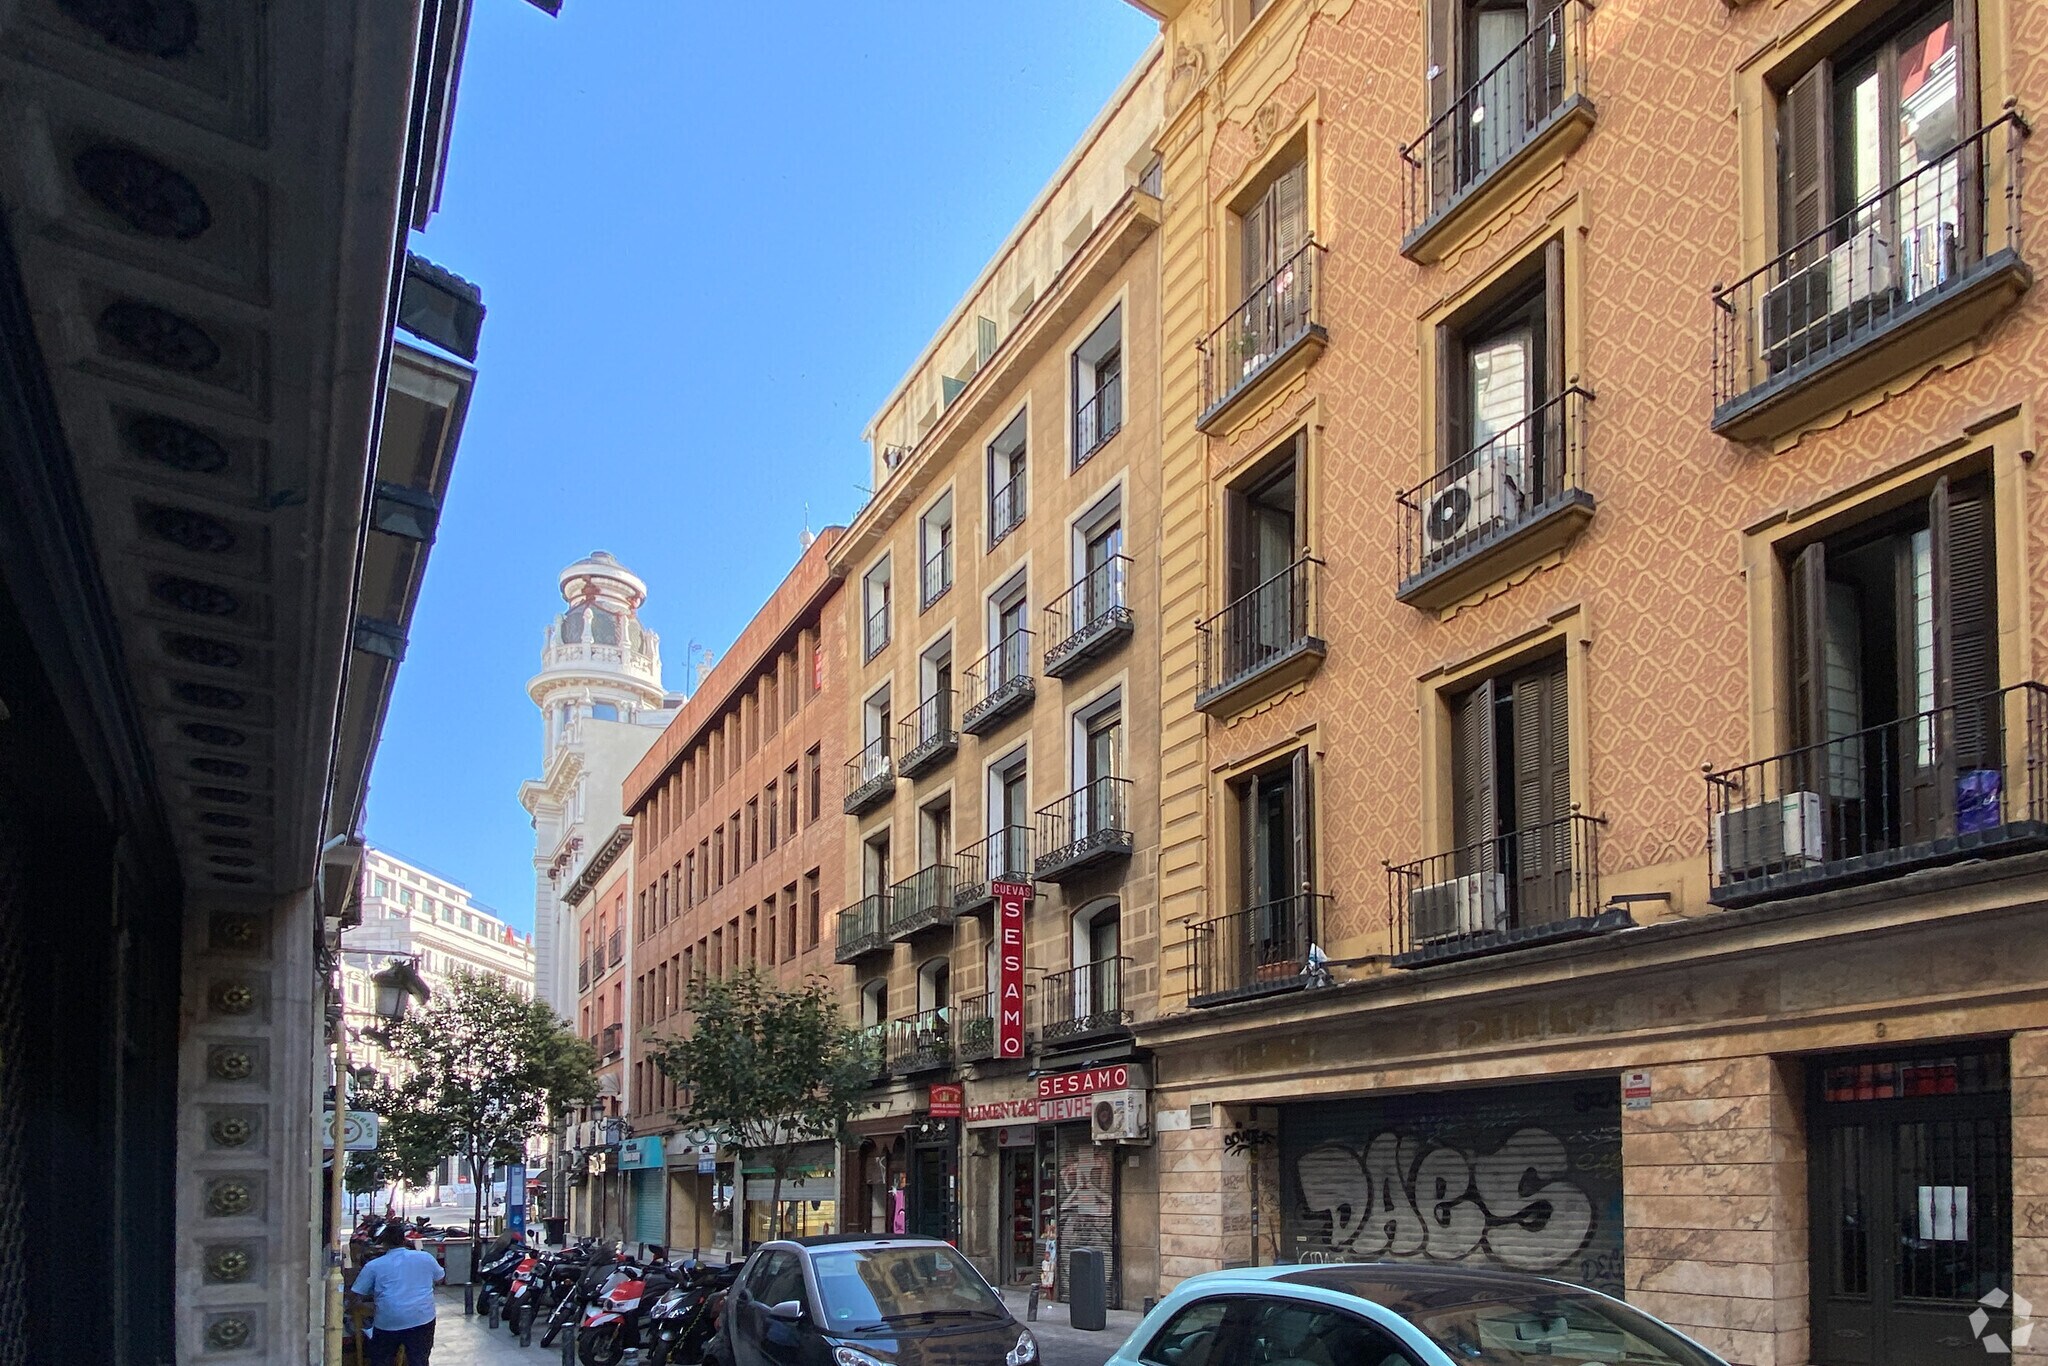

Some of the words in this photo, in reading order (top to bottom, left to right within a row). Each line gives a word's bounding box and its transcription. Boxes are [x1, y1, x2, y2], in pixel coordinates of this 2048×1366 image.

[993, 883, 1031, 897] CUEVAS
[1004, 902, 1020, 1053] SESAMO
[1040, 1068, 1126, 1096] SESAMO
[1037, 1097, 1092, 1121] CUEVAS
